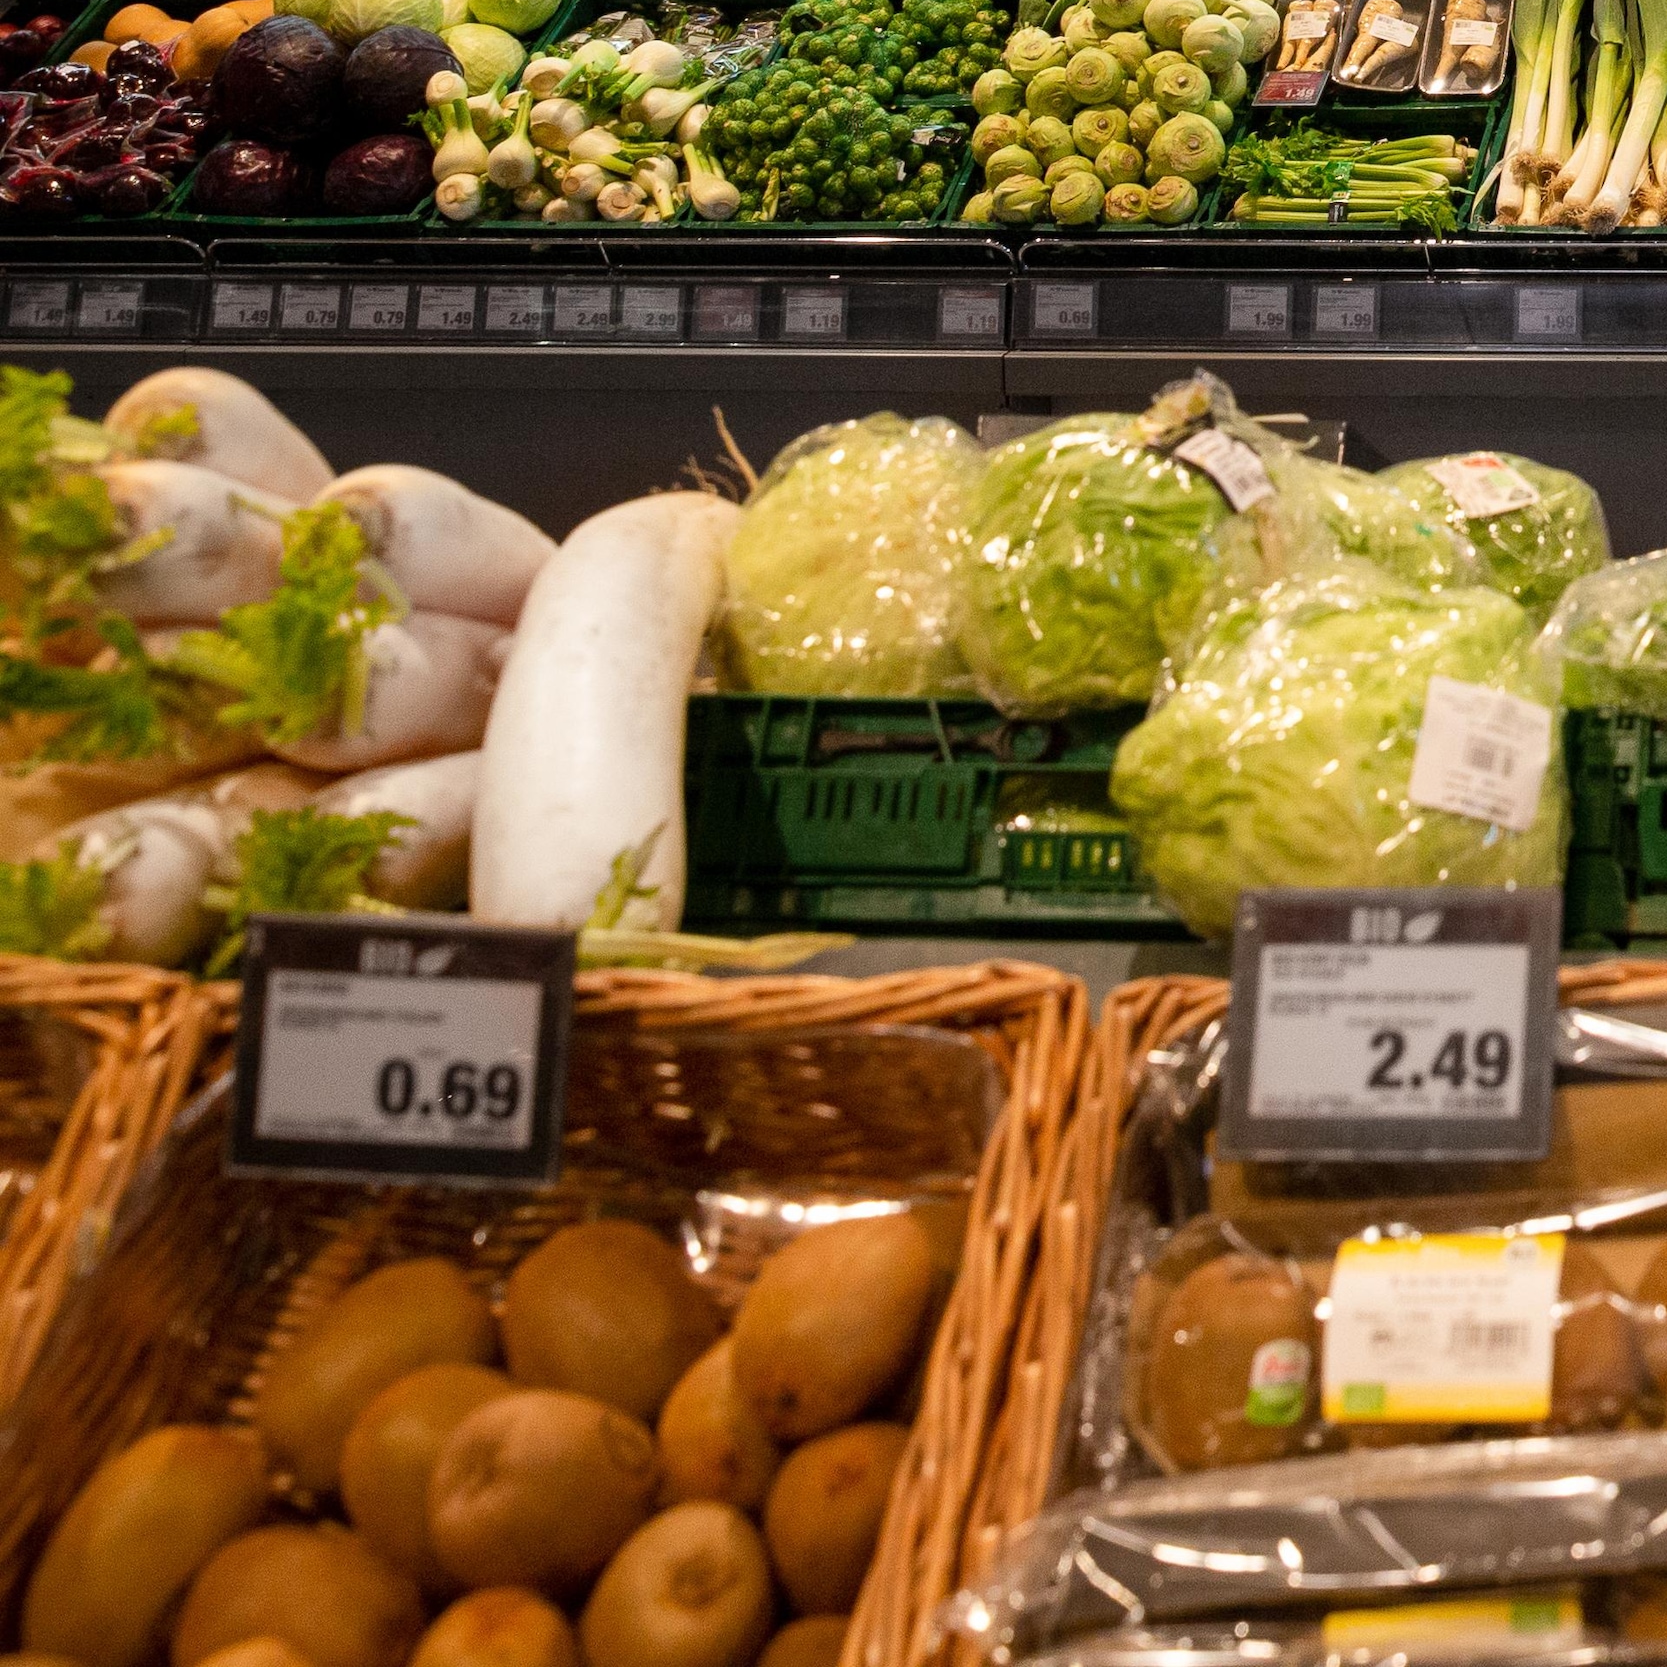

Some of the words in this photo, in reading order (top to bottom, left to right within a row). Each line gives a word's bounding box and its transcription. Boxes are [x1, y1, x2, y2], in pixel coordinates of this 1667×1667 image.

[1284, 86, 1315, 100] 1.49
[104, 309, 136, 324] 1.49
[237, 309, 270, 324] 1.49
[304, 309, 337, 325] 0.79
[373, 309, 405, 325] 0.79
[441, 310, 473, 326] 1.49
[508, 311, 543, 327] 2.49
[645, 312, 680, 328] 2.99
[809, 313, 841, 330] 1.19
[1058, 310, 1090, 326] 0.69
[1252, 311, 1286, 328] 1.99
[1340, 312, 1374, 329] 1.99
[1542, 314, 1577, 332] 1.99
[1349, 906, 1402, 944] BIO
[359, 937, 414, 974] BIO
[1362, 1028, 1515, 1090] 2.49
[376, 1057, 523, 1121] 0.69
